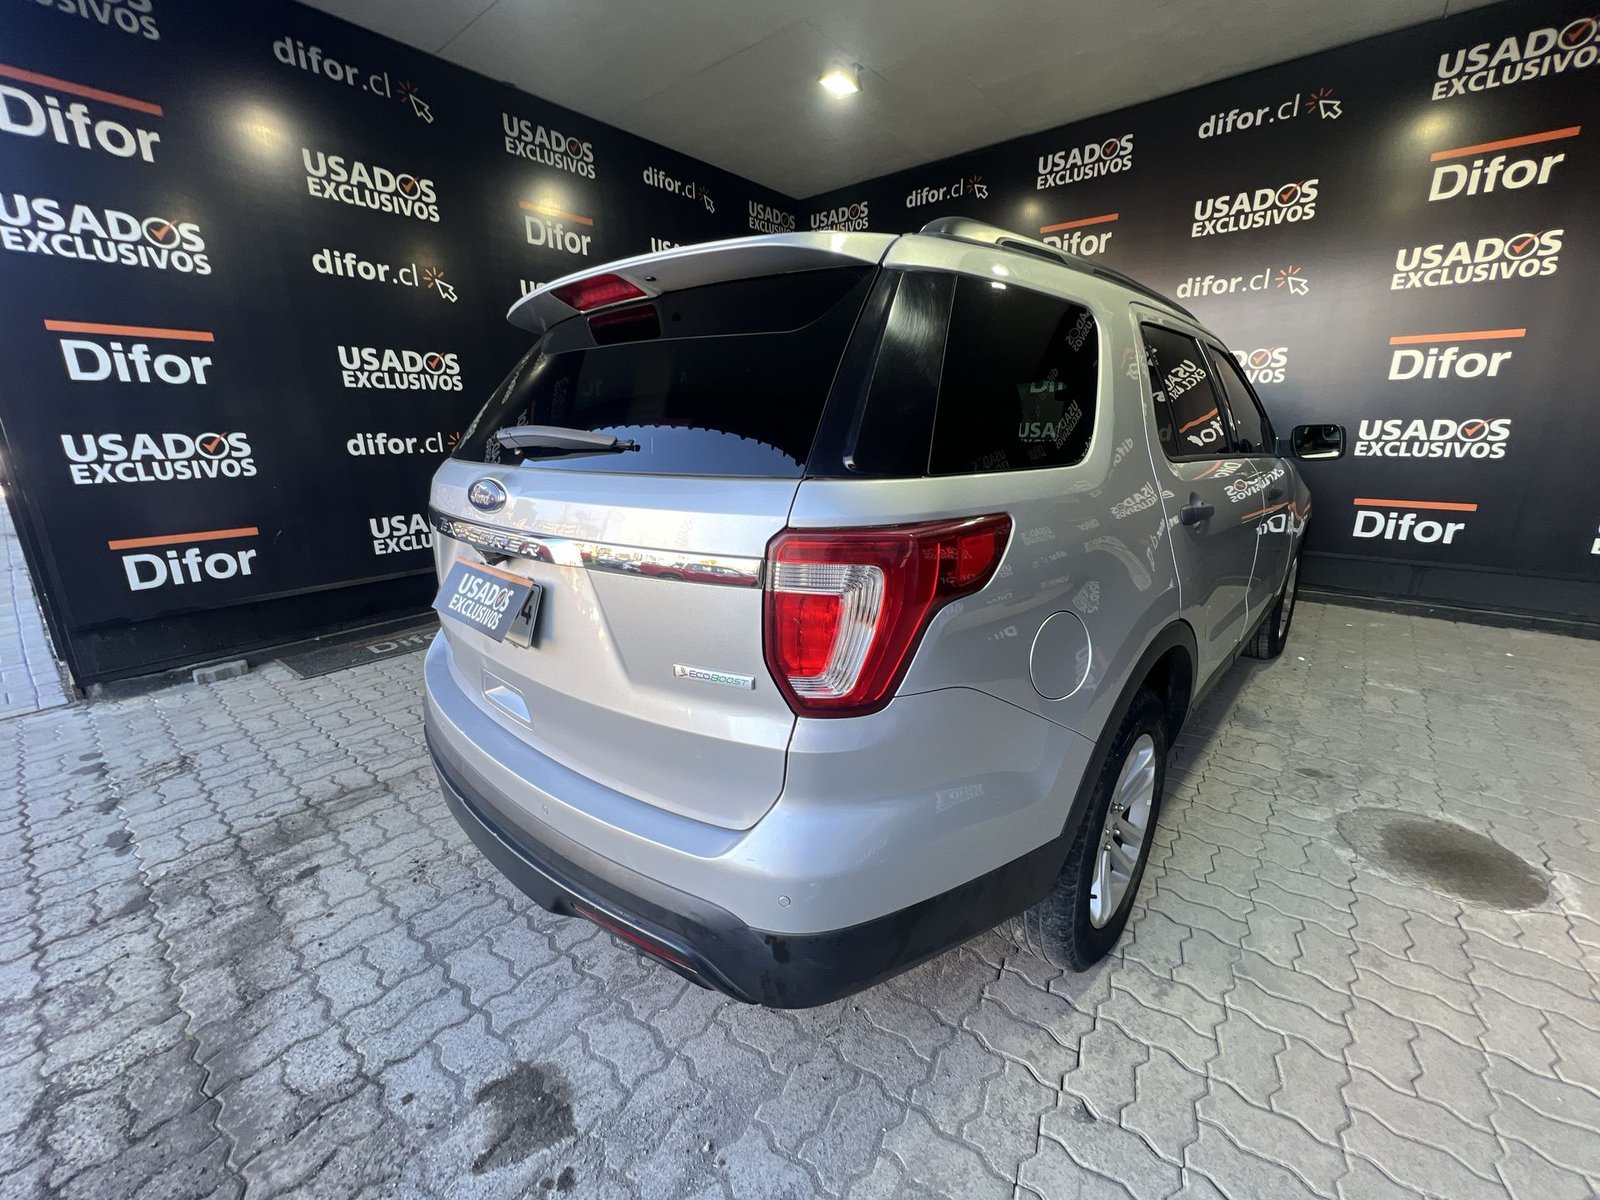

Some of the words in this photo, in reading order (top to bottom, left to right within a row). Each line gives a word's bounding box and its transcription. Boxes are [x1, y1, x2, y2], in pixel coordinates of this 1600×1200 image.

[35, 0, 160, 40] SIVOS
[1437, 17, 1600, 79] USADO
[273, 36, 390, 98] difor.cl
[1431, 45, 1600, 101] EXCLUSIVO
[0, 84, 160, 163] Difor
[1198, 94, 1300, 139] difor.cl
[502, 112, 594, 164] USADOS
[1037, 134, 1134, 176] USADOS
[301, 148, 437, 203] USADOS
[505, 136, 596, 180] EXCLUSIVOS
[1036, 155, 1132, 190] EXCLUSIVOS
[643, 166, 697, 200] difor.cl
[906, 178, 964, 208] difor.cl
[1428, 153, 1565, 202] Difor
[306, 176, 440, 223] EXCLUSIVOS
[748, 200, 796, 230] USADOS
[810, 201, 869, 229] USADOS
[1193, 178, 1319, 221] USADOS
[0, 194, 206, 253] USADOS
[524, 215, 592, 256] Difor
[749, 217, 795, 233] EXCLUSI
[811, 218, 869, 232] USIVOS
[1191, 202, 1316, 238] EXCLUSIVOS
[0, 228, 212, 276] EXCLUSIVOS
[312, 249, 419, 287] difor.cl
[1395, 229, 1564, 272] USADOS
[1176, 268, 1271, 298] difor.cl
[1390, 256, 1558, 290] EXCLUSIVOS
[60, 338, 213, 385] Difor
[338, 345, 460, 375] USADOS
[1230, 347, 1288, 369] DOS
[1388, 347, 1512, 381] Difor
[342, 371, 463, 391] EXCLUSIVOS
[61, 431, 252, 462] USADOS
[346, 432, 444, 456] difor.cl
[1358, 418, 1512, 443] USADOS
[1354, 440, 1507, 459] EXCLUSIVOS
[70, 458, 257, 485] EXCLUSIVOS
[369, 513, 430, 539] USA
[1352, 510, 1466, 544] Difor
[373, 533, 434, 556] EXCLU
[122, 547, 257, 591] Difor
[458, 573, 515, 612] USADOS
[448, 593, 503, 630] EXCLUSIVOS
[366, 632, 438, 654] Dif
[688, 670, 749, 686] ECOBOOST
